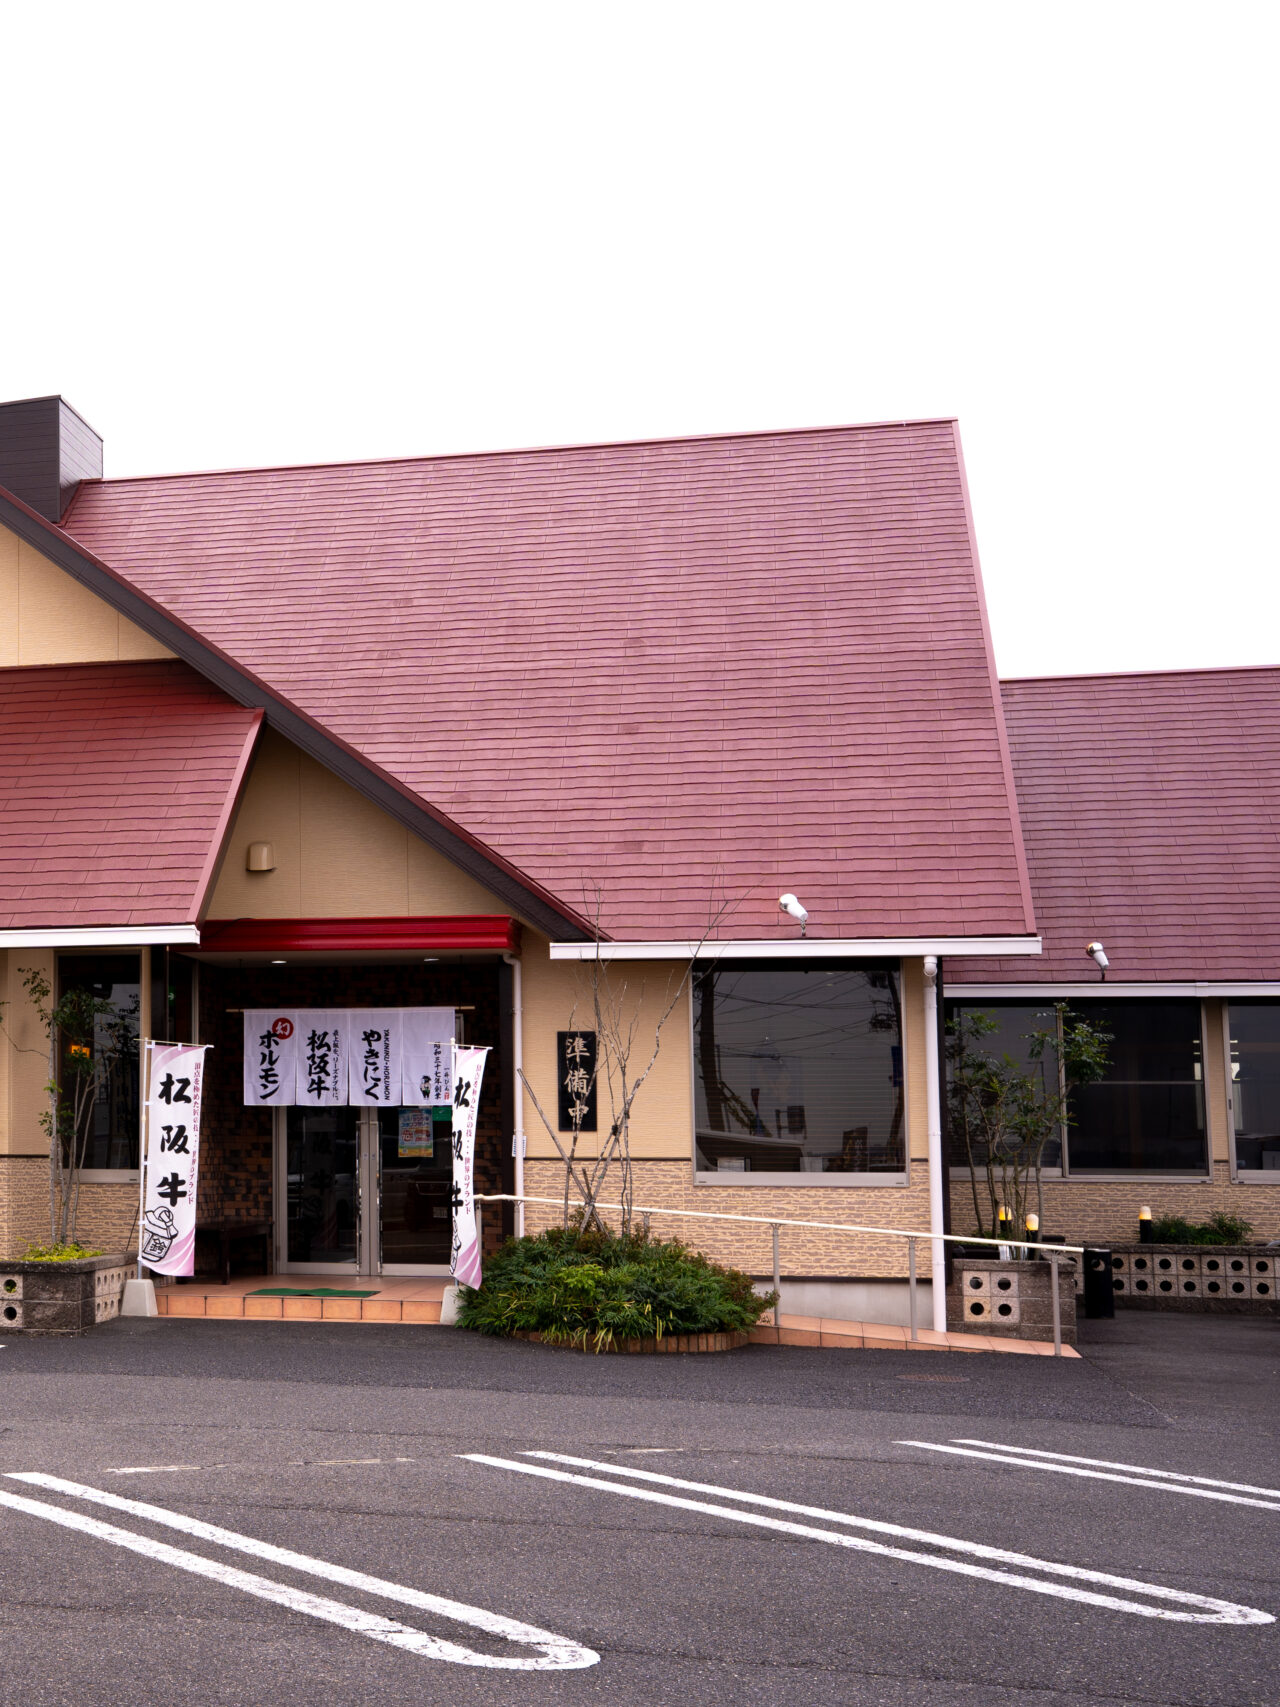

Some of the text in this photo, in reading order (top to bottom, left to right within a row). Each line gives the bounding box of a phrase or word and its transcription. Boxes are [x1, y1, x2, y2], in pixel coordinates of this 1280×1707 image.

[275, 1021, 291, 1036] 幻
[259, 1030, 280, 1100] ホルモン
[306, 1029, 332, 1100] 松阪牛
[361, 1029, 382, 1101] やきにく
[564, 1036, 590, 1125] 準備中
[156, 1072, 192, 1207] 松阪牛
